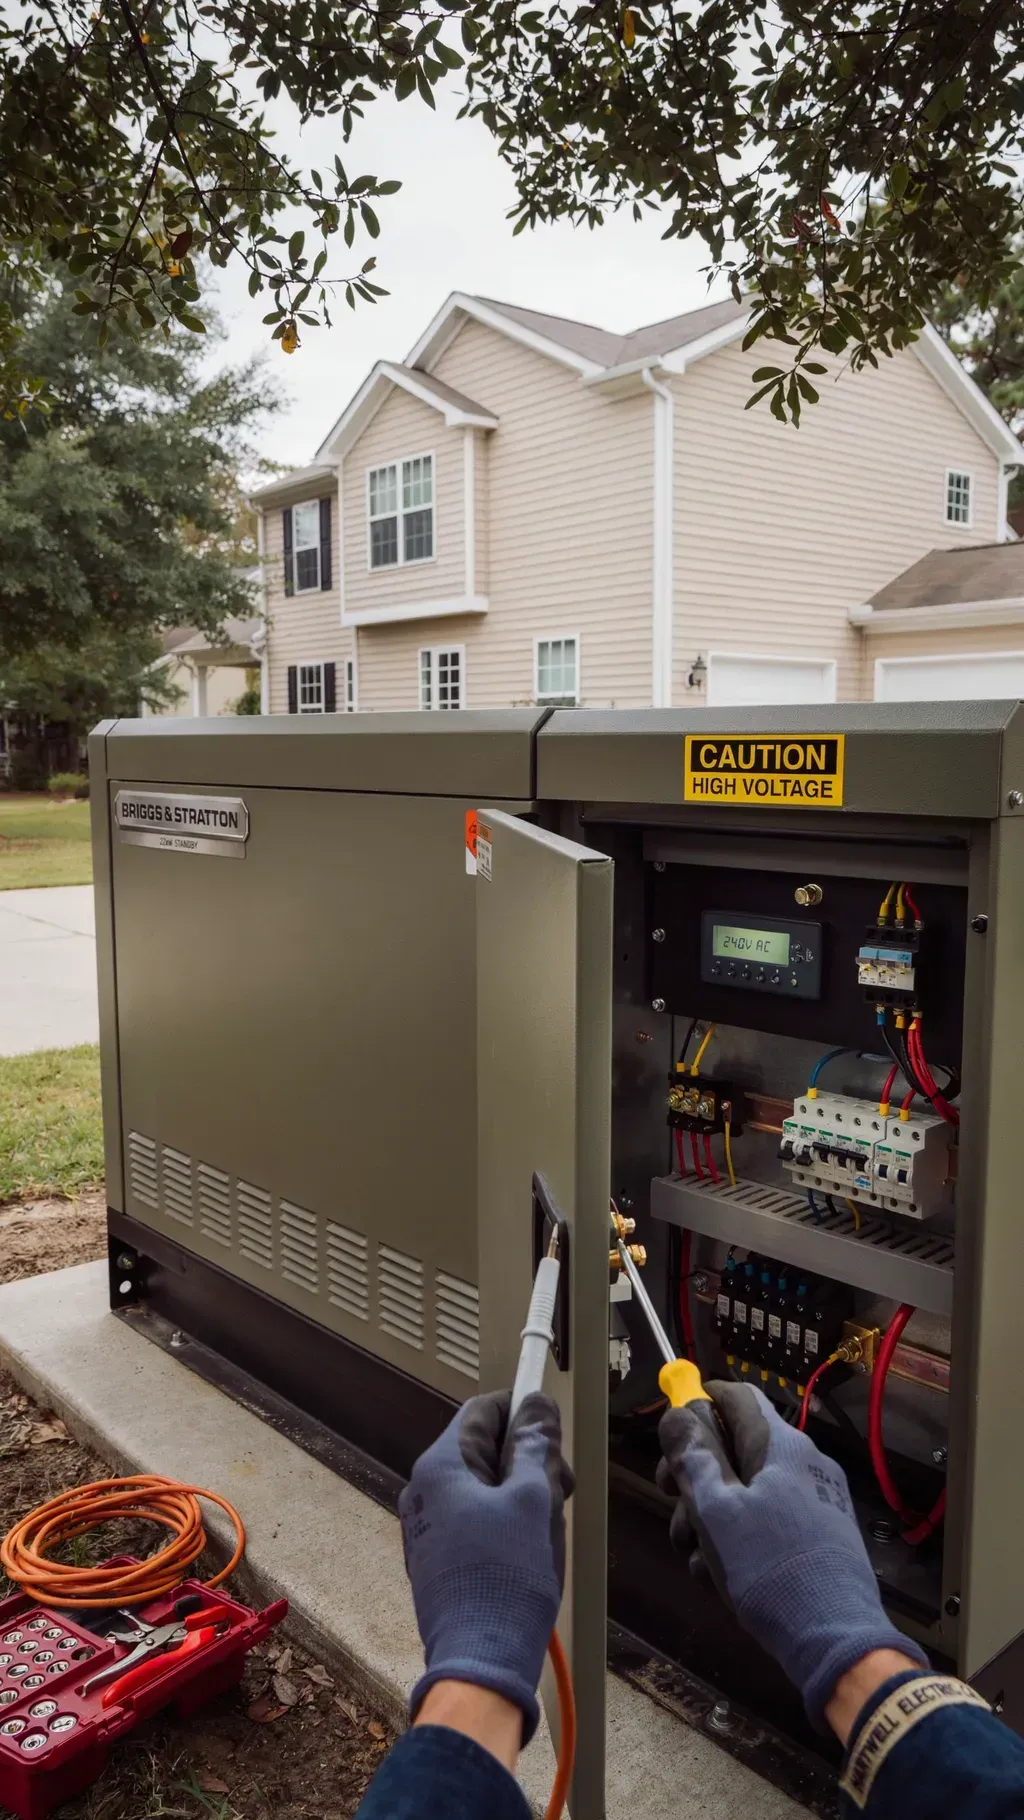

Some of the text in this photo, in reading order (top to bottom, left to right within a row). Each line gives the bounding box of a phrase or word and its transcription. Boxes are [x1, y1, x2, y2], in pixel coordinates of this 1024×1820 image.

[699, 743, 826, 770] CAUTION
[693, 777, 833, 798] HIGH VOLTAGE
[122, 802, 238, 829] BRIGGS & STRATTON
[174, 839, 199, 849] STANDBY
[723, 936, 771, 953] 240V AC
